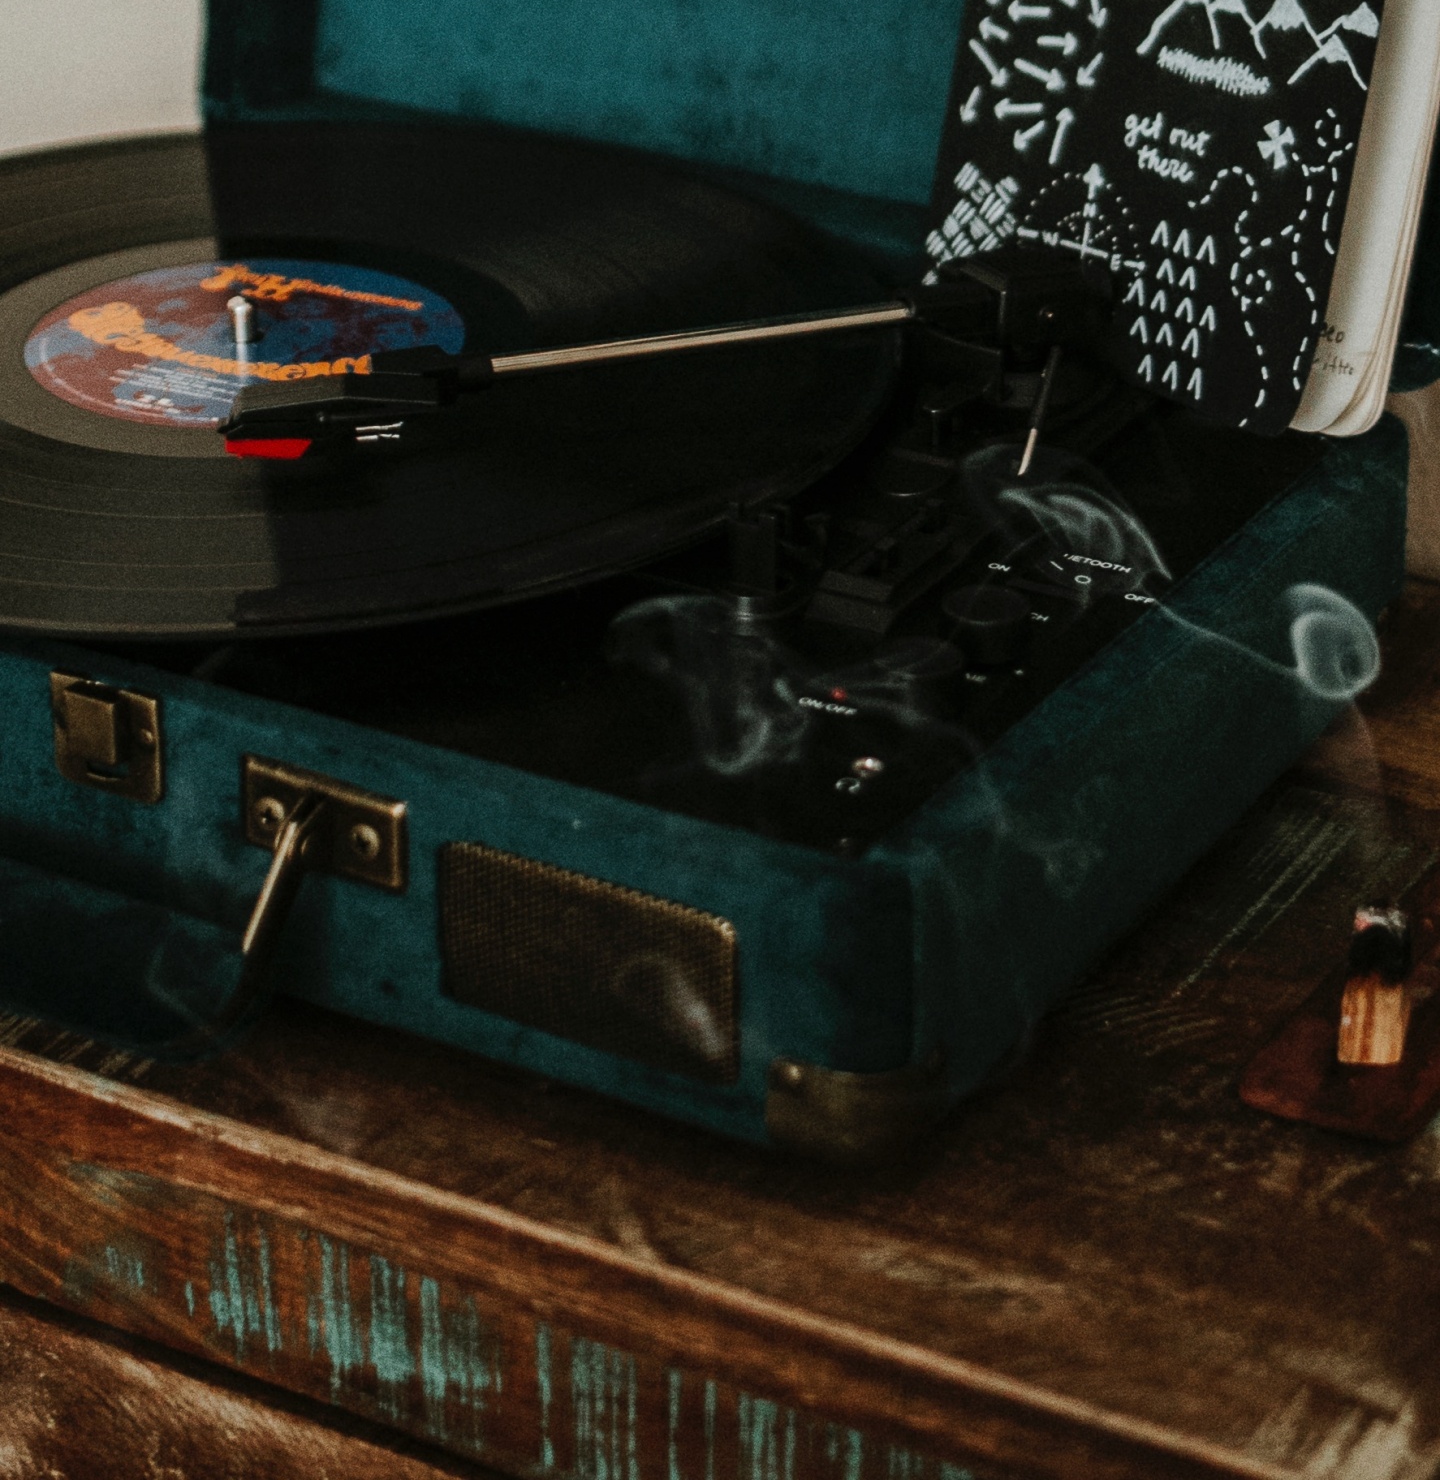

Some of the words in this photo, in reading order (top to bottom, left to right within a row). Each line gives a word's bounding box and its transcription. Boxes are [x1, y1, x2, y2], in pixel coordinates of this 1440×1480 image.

[1124, 111, 1163, 148] get
[1169, 128, 1211, 157] out
[1137, 144, 1194, 183] there
[1082, 202, 1097, 218] N
[1042, 231, 1059, 247] W
[1110, 253, 1122, 272] E
[988, 562, 1011, 572] ON
[1124, 593, 1156, 604] OFF
